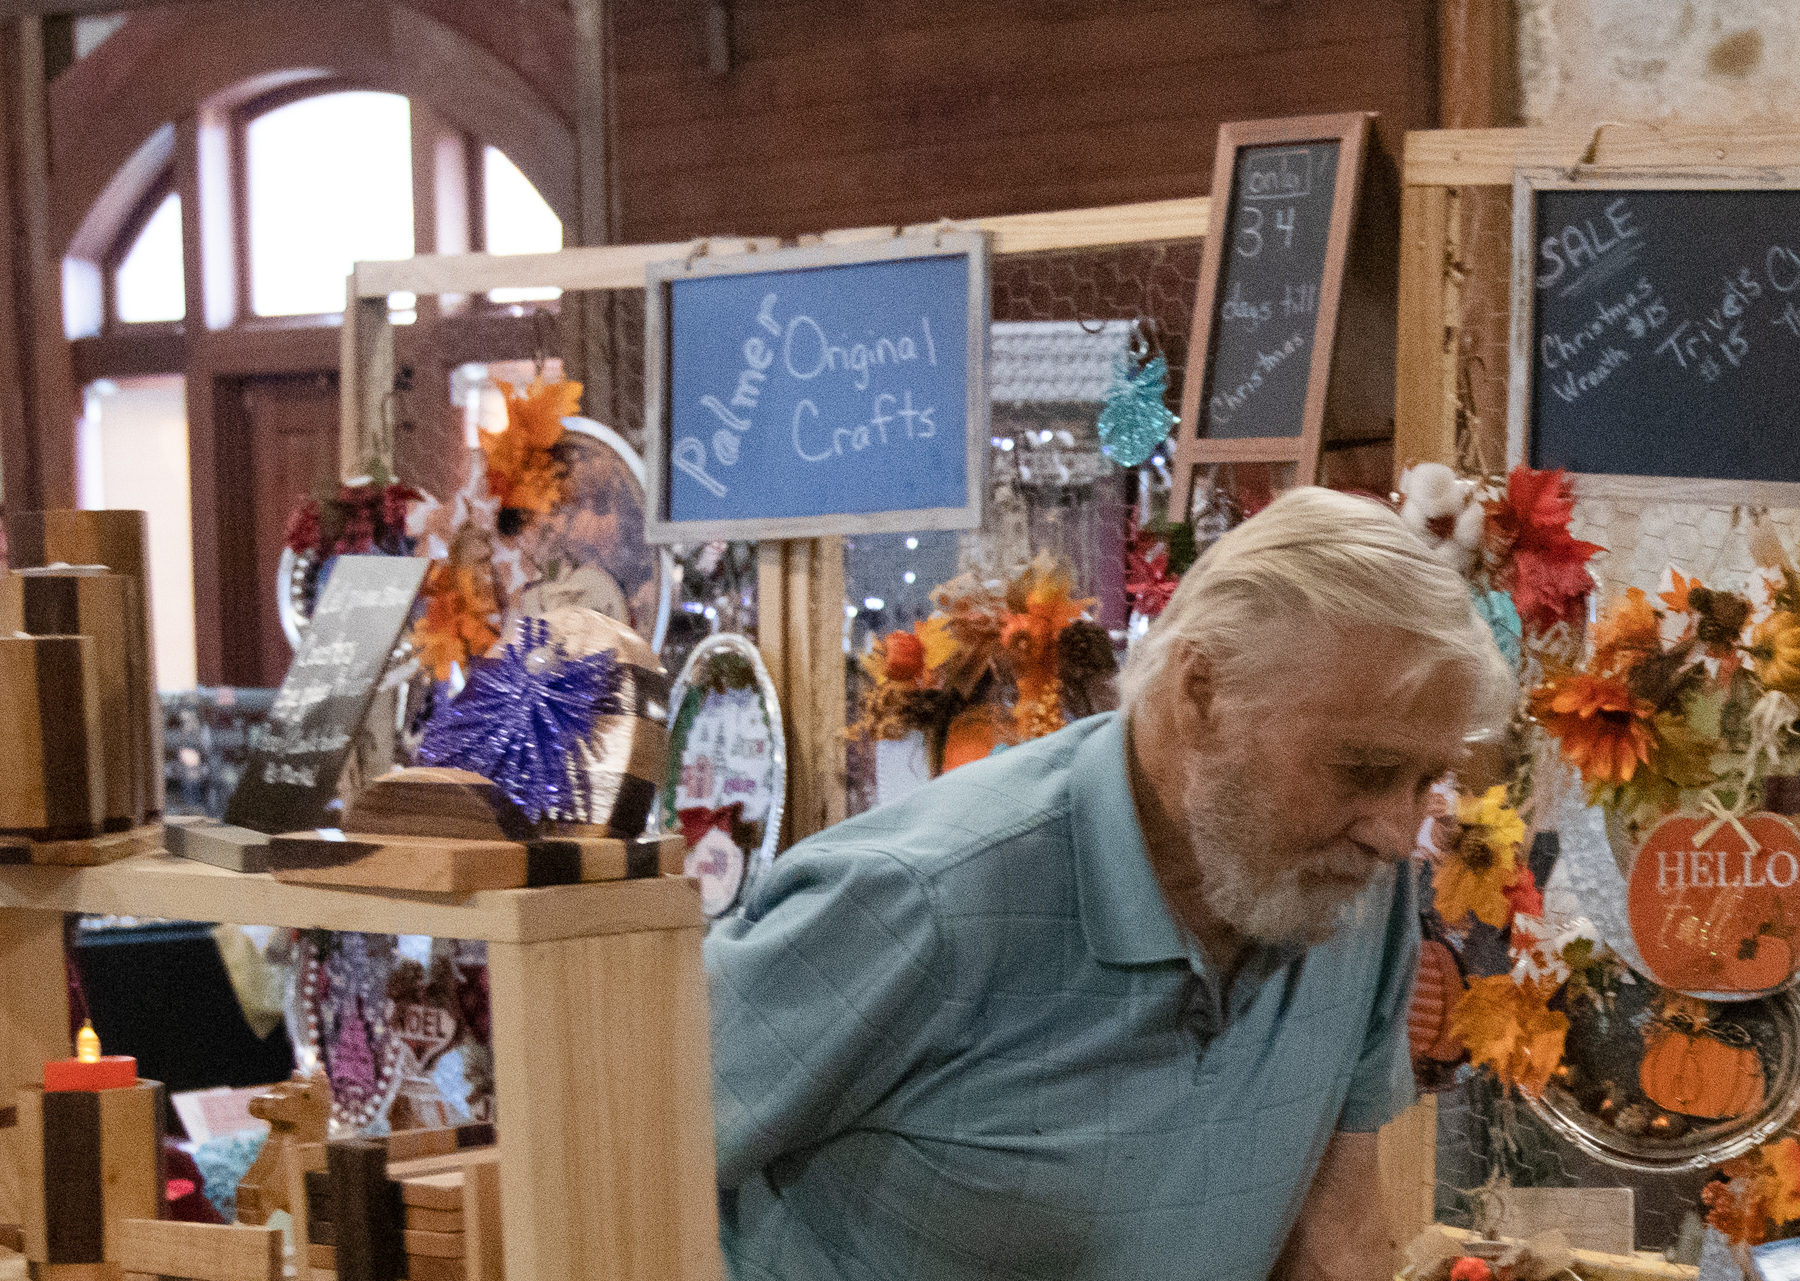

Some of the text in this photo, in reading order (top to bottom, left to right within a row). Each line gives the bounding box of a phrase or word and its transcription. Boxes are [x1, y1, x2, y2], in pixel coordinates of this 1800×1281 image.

[1537, 198, 1638, 288] SALE
[784, 314, 937, 391] Original
[673, 293, 783, 497] Palmer
[792, 390, 937, 462] Crafts
[1657, 850, 1800, 890] HELLO
